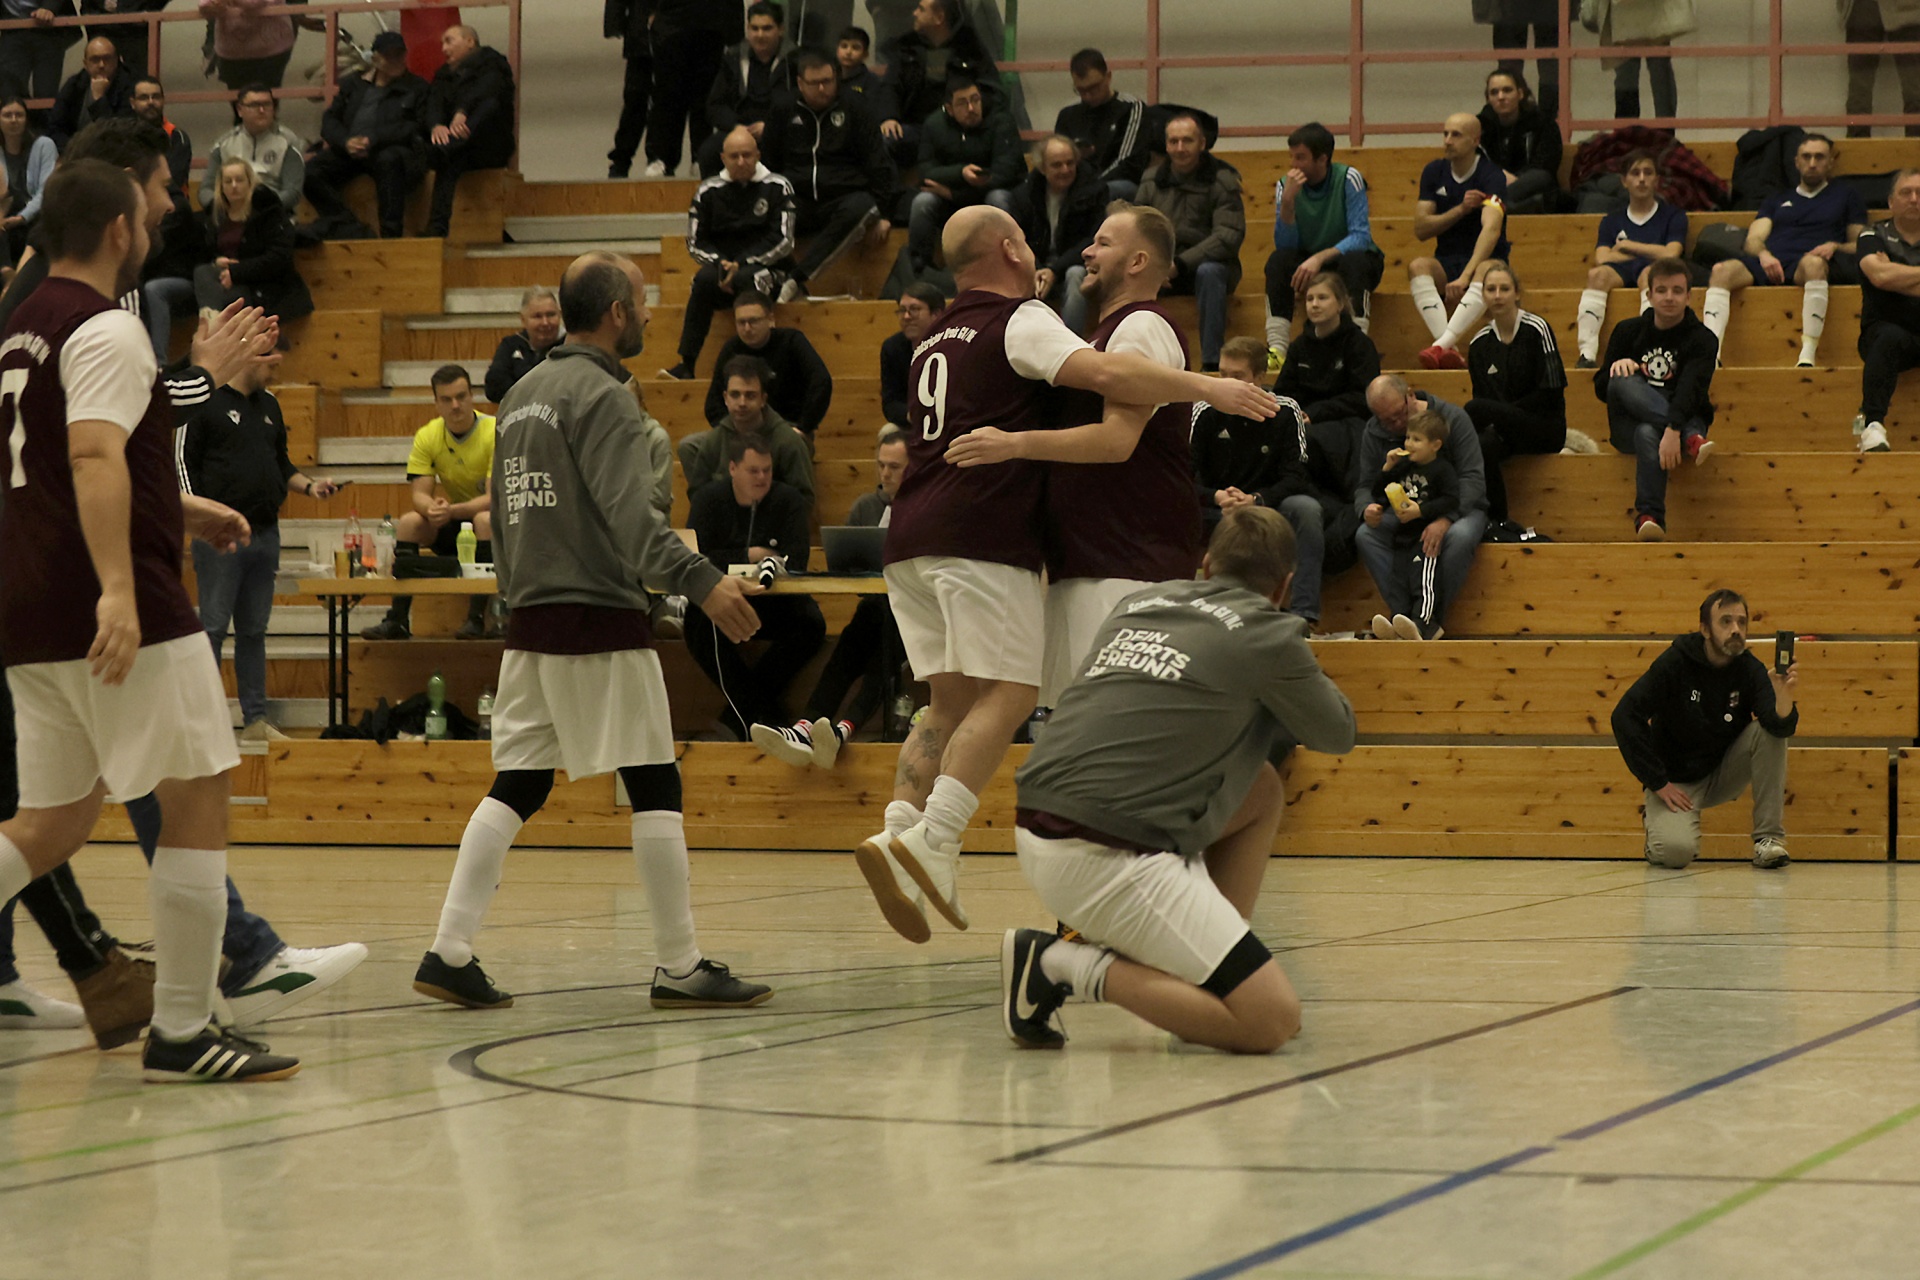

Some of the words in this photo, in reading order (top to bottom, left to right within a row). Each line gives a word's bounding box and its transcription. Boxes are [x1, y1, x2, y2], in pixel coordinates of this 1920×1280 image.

[918, 352, 948, 441] 9
[0, 367, 29, 489] 7
[505, 472, 553, 494] SPORTS
[507, 490, 557, 512] FRUND
[1114, 628, 1169, 643] DEIN
[1094, 648, 1182, 681] FREUND
[1108, 641, 1191, 669] SPORTS
